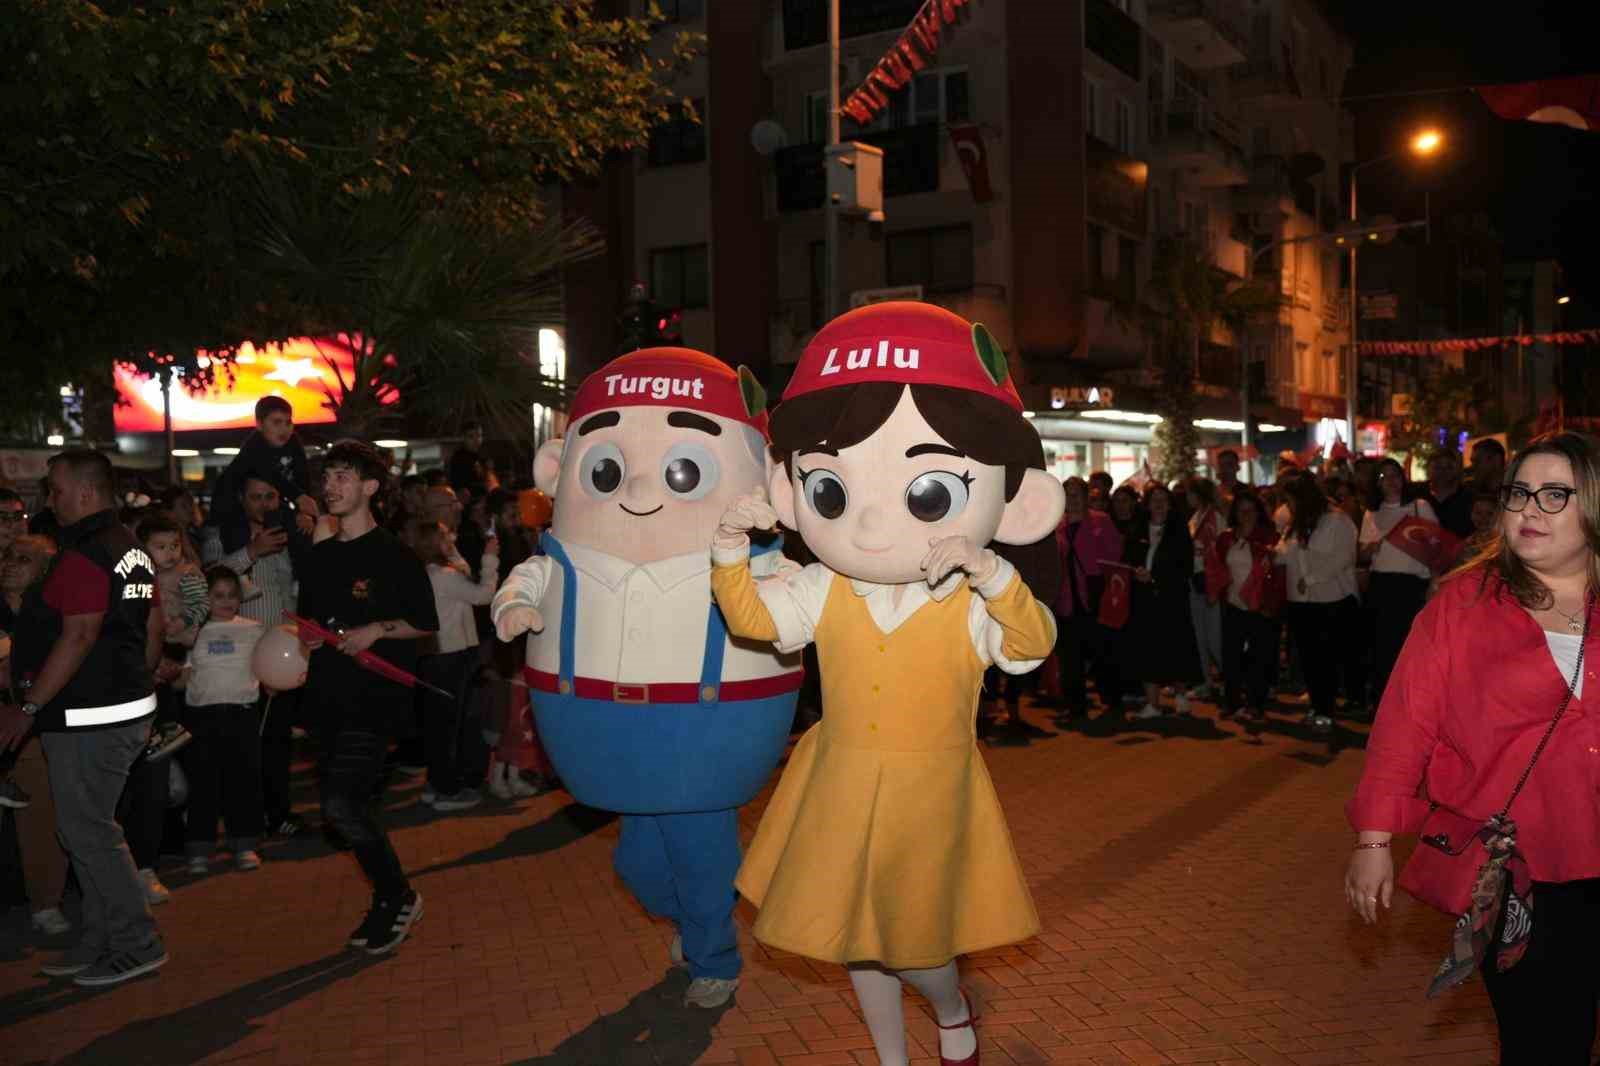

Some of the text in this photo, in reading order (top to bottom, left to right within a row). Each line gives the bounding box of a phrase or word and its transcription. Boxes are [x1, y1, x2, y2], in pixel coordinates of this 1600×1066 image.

[820, 340, 920, 377] Lulu
[604, 374, 704, 400] Turgut
[113, 548, 156, 579] TURGUTL
